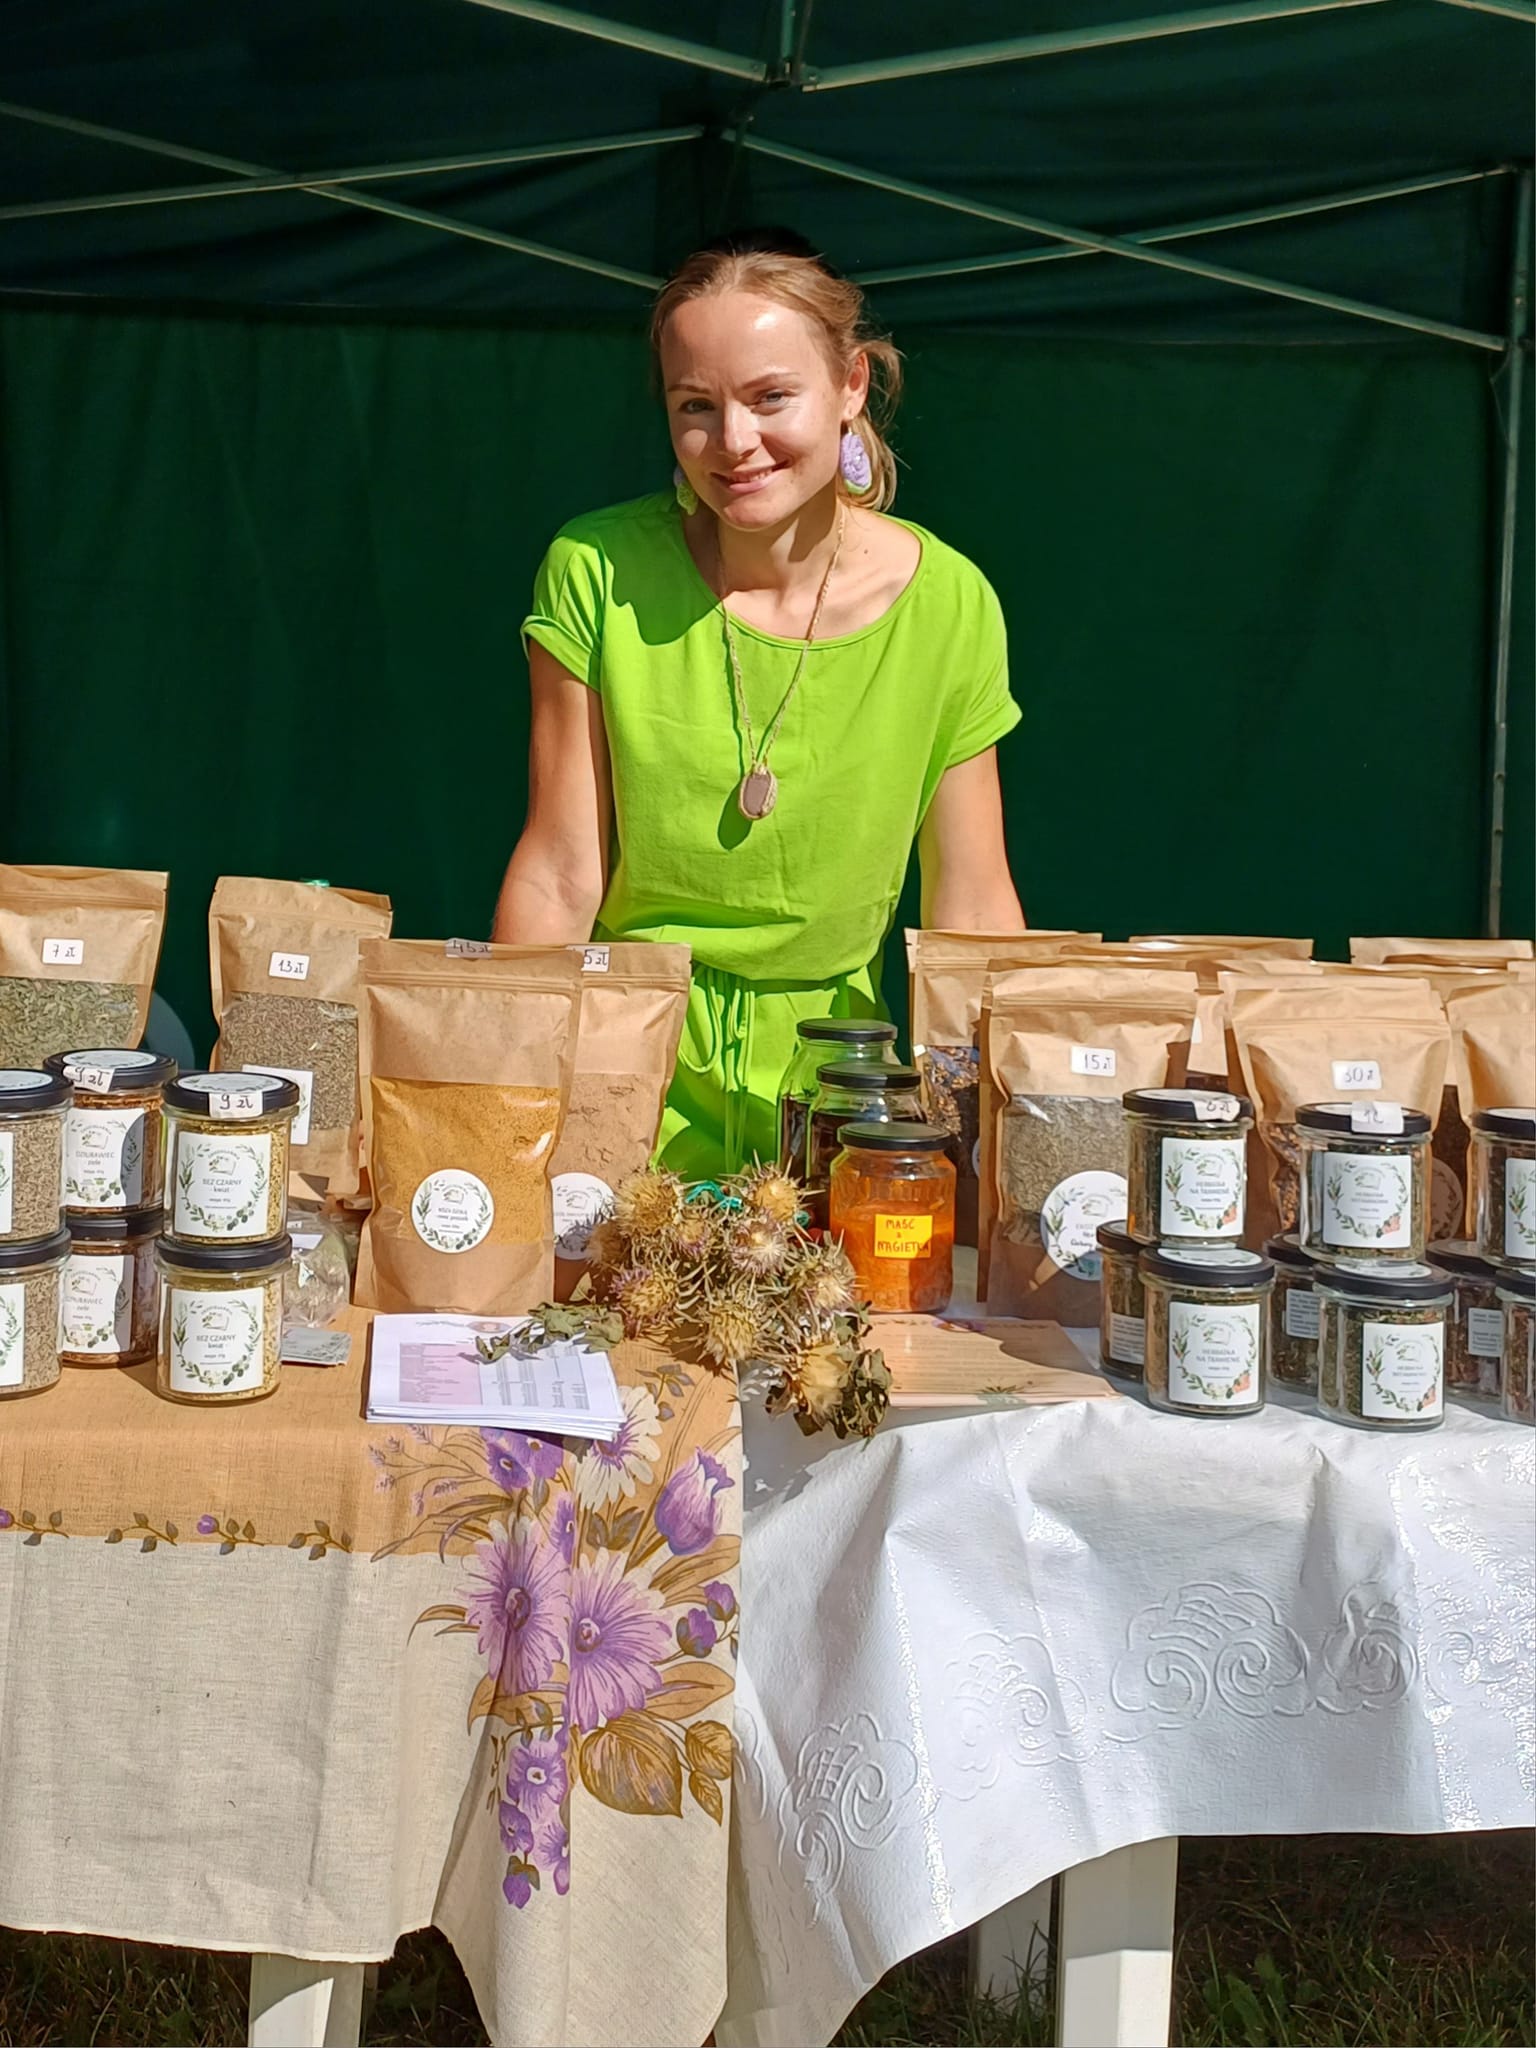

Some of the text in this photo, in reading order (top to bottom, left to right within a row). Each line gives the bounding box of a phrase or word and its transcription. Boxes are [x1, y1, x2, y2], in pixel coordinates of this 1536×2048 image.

[52, 943, 60, 958] 7
[1084, 1053, 1101, 1070] 15
[74, 1066, 110, 1087] 9 zł
[219, 1092, 255, 1110] 9 zł
